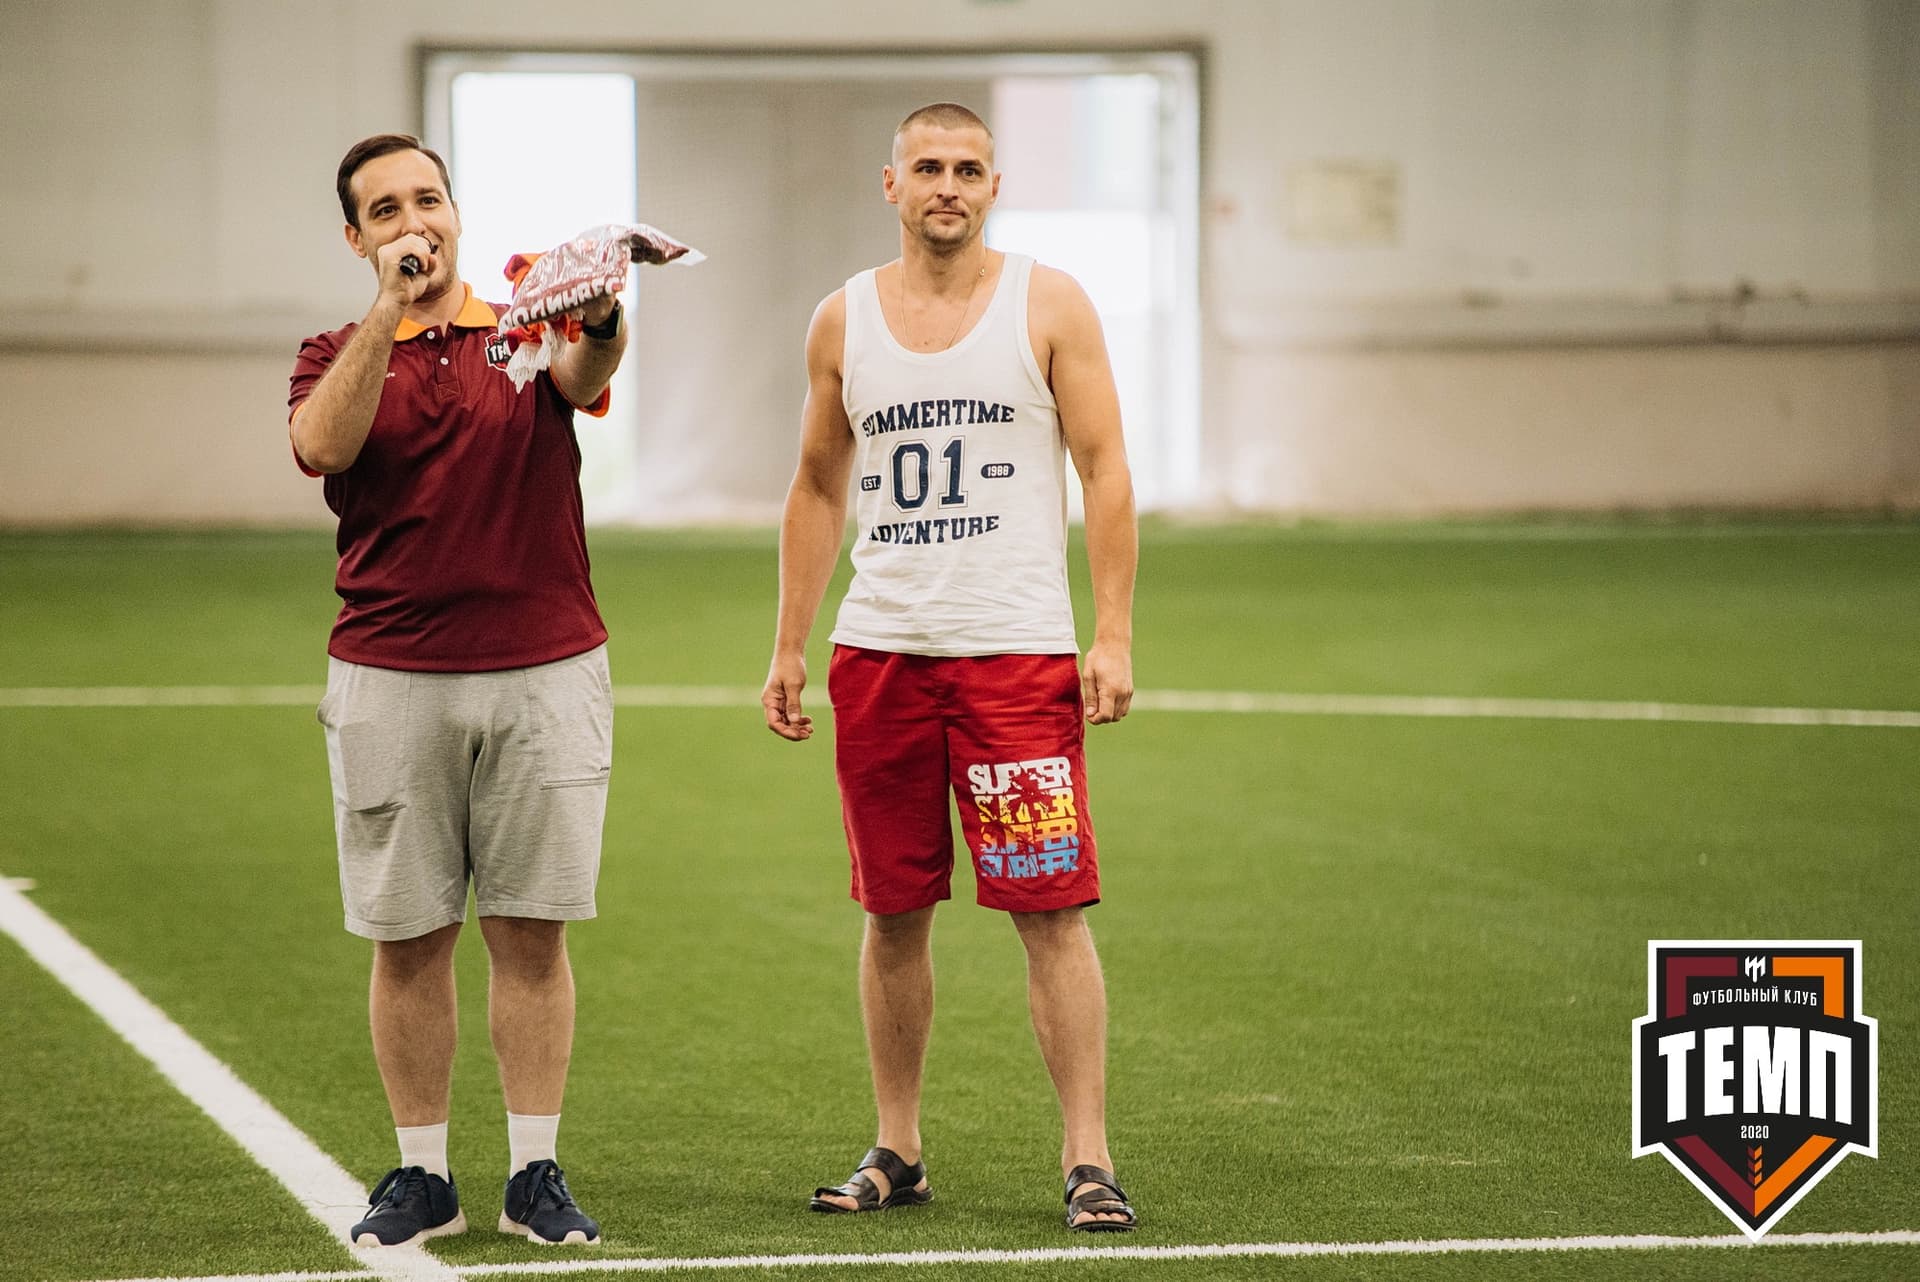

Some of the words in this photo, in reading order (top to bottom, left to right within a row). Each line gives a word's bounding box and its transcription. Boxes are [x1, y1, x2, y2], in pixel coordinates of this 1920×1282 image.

[862, 399, 1015, 437] SUMMERTIME
[863, 477, 881, 490] EST.
[890, 435, 968, 513] 01
[868, 515, 1000, 545] ADVENTURE
